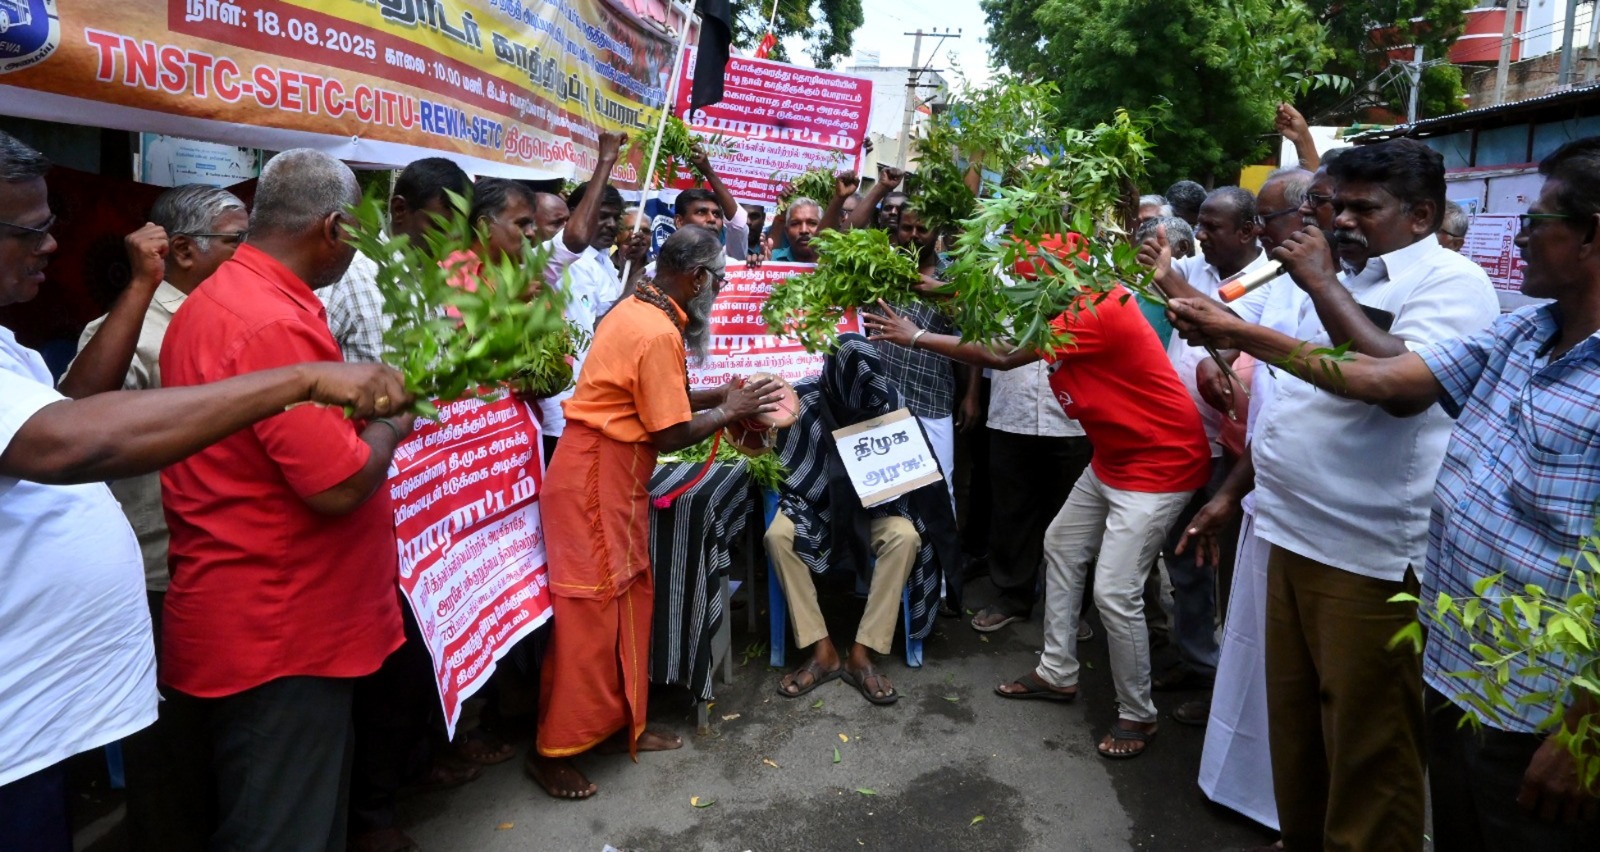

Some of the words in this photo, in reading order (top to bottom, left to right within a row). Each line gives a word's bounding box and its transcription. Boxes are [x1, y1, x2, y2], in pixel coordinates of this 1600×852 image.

[0, 41, 21, 54] EWA
[254, 9, 376, 60] 18.08.2025
[384, 47, 426, 74] காலை
[432, 60, 461, 89] 10.00
[731, 60, 791, 84] போக்குவரத்து
[594, 89, 653, 129] போராட்
[781, 97, 815, 112] தி.மு.க
[816, 104, 860, 119] அரசுக்கு
[821, 87, 863, 103] போராட்டம்
[683, 108, 857, 150] போராட்டம்
[505, 123, 589, 171] திருநெல்வேலி
[590, 159, 637, 182] மடலம்
[449, 445, 488, 472] தி.மு.க
[489, 431, 529, 455] அரசுக்கு
[853, 430, 910, 462] திமுக
[443, 466, 490, 496] உடுக்கை
[862, 454, 926, 487] அரசு!
